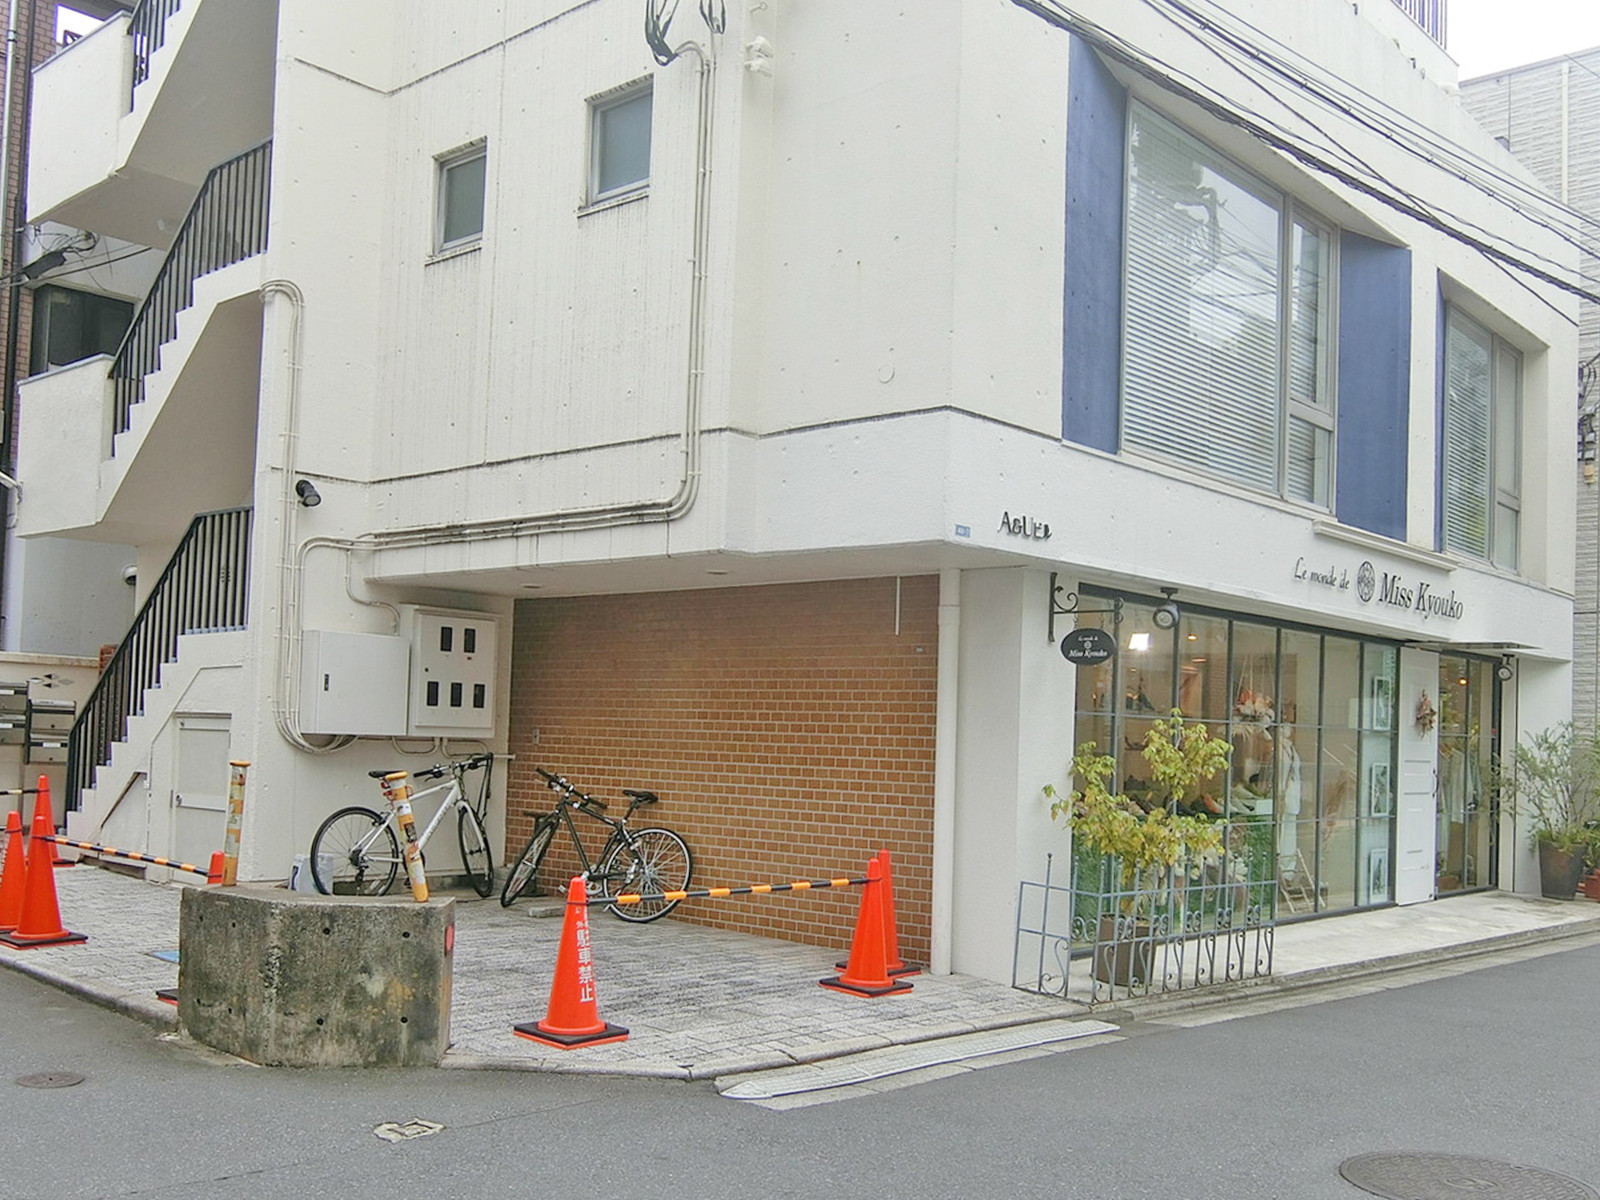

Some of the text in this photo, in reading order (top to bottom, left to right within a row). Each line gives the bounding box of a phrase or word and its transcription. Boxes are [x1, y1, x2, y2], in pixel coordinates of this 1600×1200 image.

[1294, 557, 1350, 590] Le monde de
[1379, 572, 1463, 620] Miss Kyouko
